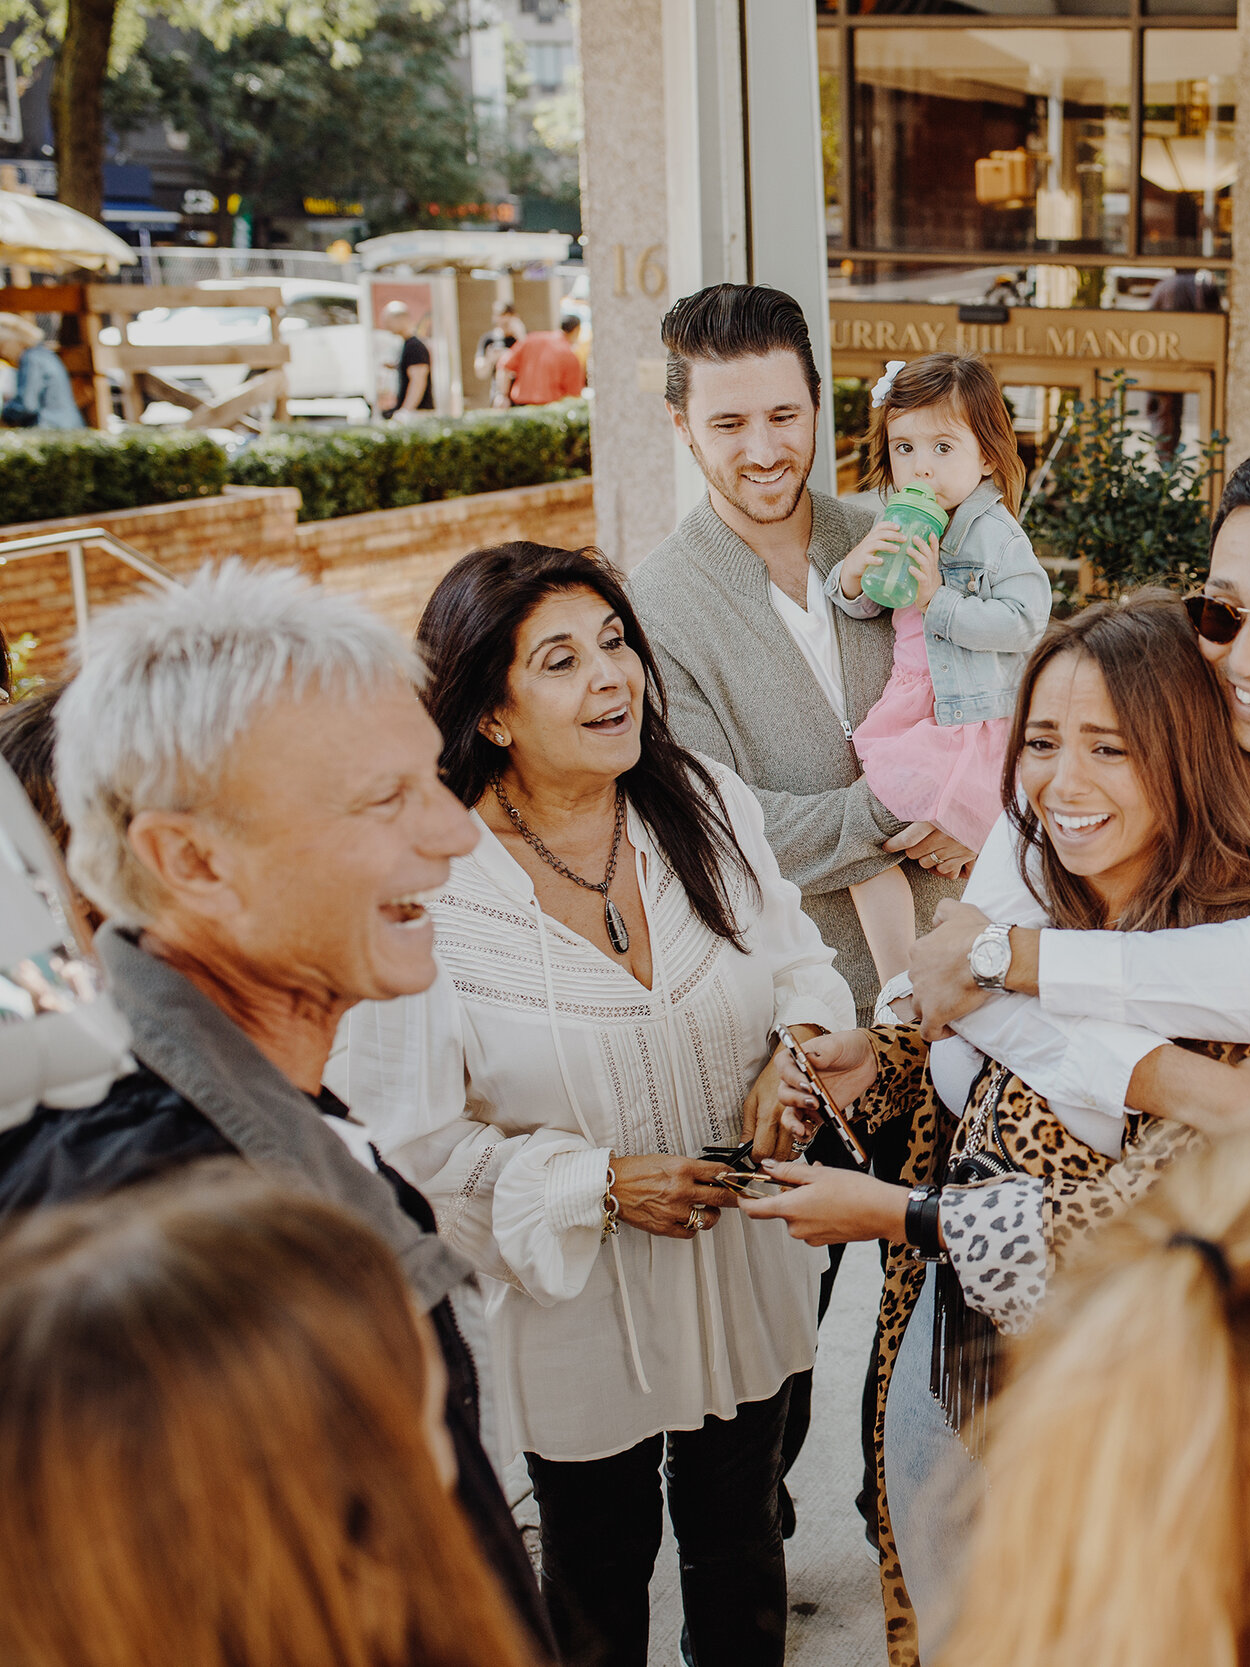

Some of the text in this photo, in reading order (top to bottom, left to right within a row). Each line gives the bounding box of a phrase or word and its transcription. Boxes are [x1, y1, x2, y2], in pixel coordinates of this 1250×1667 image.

[612, 243, 669, 298] 16
[829, 319, 1181, 361] URRAY HILL MANOR
